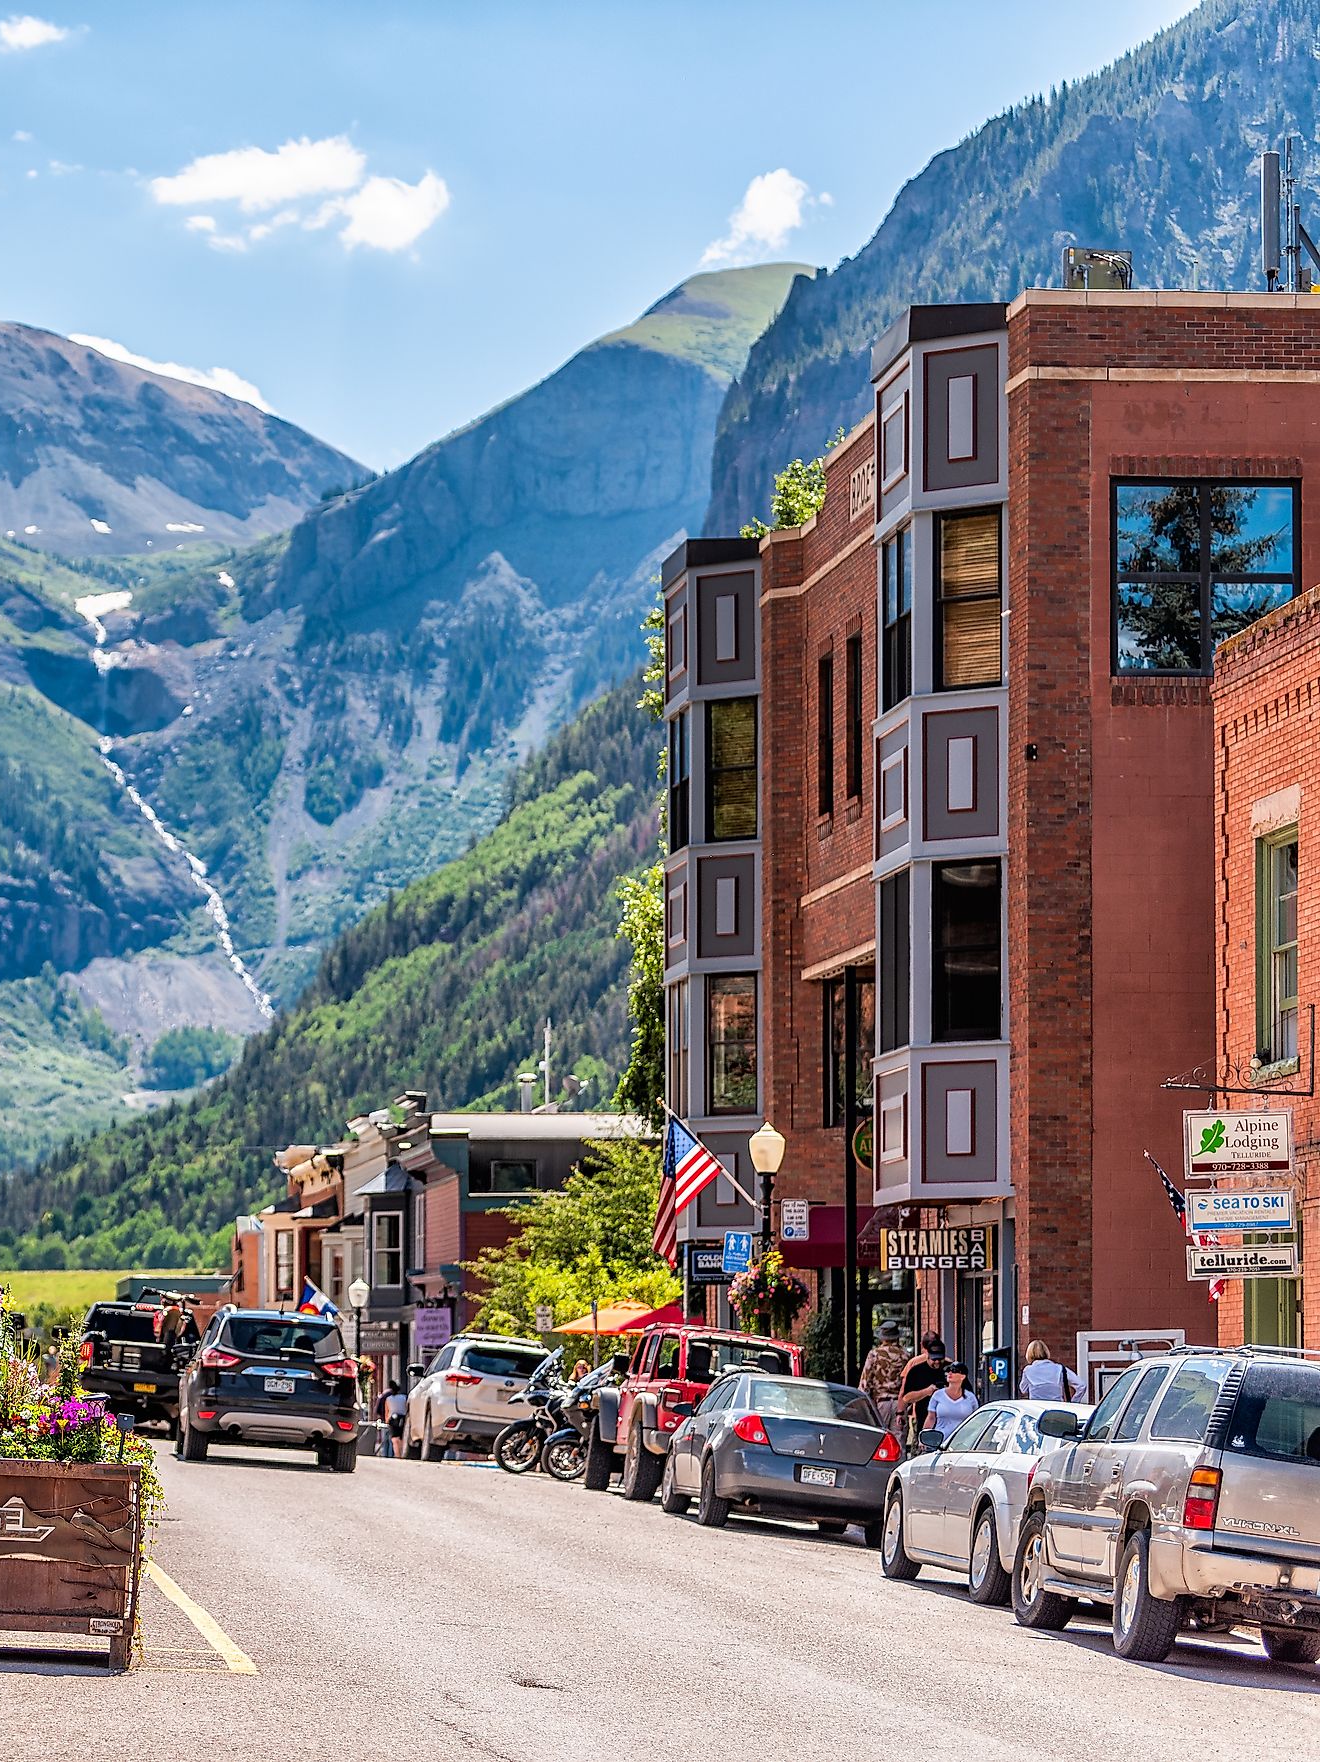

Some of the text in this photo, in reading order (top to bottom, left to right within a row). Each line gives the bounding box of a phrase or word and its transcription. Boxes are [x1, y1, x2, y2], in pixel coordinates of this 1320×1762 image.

[1235, 1119, 1279, 1134] Alpine
[1225, 1135, 1279, 1150] Lodging
[1212, 1162, 1269, 1171] 970-728-3388
[1262, 1196, 1284, 1208] SKI
[888, 1230, 968, 1256] STEAMIES
[888, 1256, 984, 1269] BURGER
[1200, 1253, 1287, 1267] telluride.com
[1221, 1517, 1300, 1536] YUKON XL
